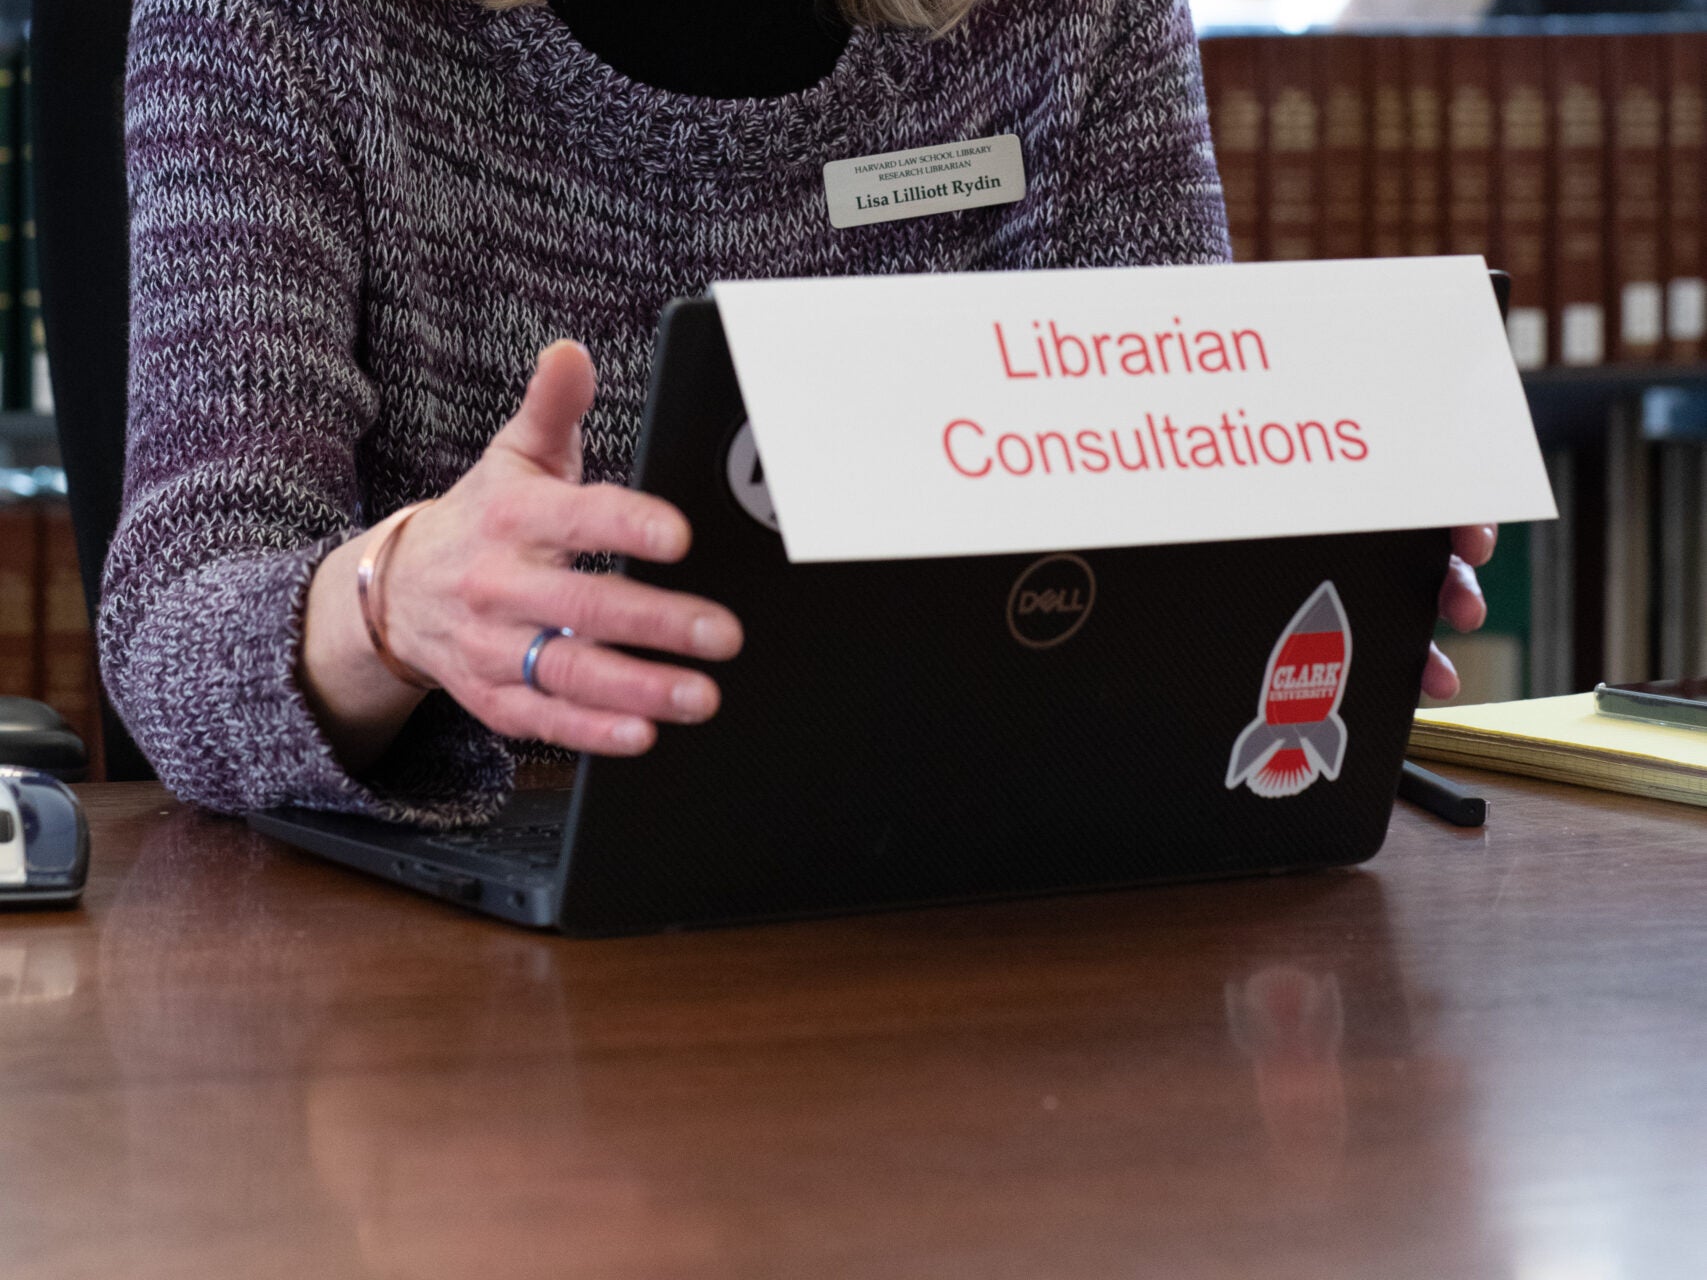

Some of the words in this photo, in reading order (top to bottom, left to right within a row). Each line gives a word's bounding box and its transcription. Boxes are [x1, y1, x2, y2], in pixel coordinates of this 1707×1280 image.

[854, 160, 897, 174] HARVARD
[898, 157, 919, 167] LAW
[919, 150, 955, 164] SCHOOL
[956, 145, 992, 159] LIBRARY
[878, 168, 924, 182] RESEARCH
[925, 160, 972, 175] LIBRARIAN
[856, 194, 890, 210] Lisa
[893, 183, 948, 204] Lilliott
[952, 175, 1002, 197] Rydin
[993, 316, 1270, 381] Librarian
[941, 409, 1370, 479] Consultations
[1018, 587, 1084, 614] DELL
[1273, 662, 1341, 689] CLARK
